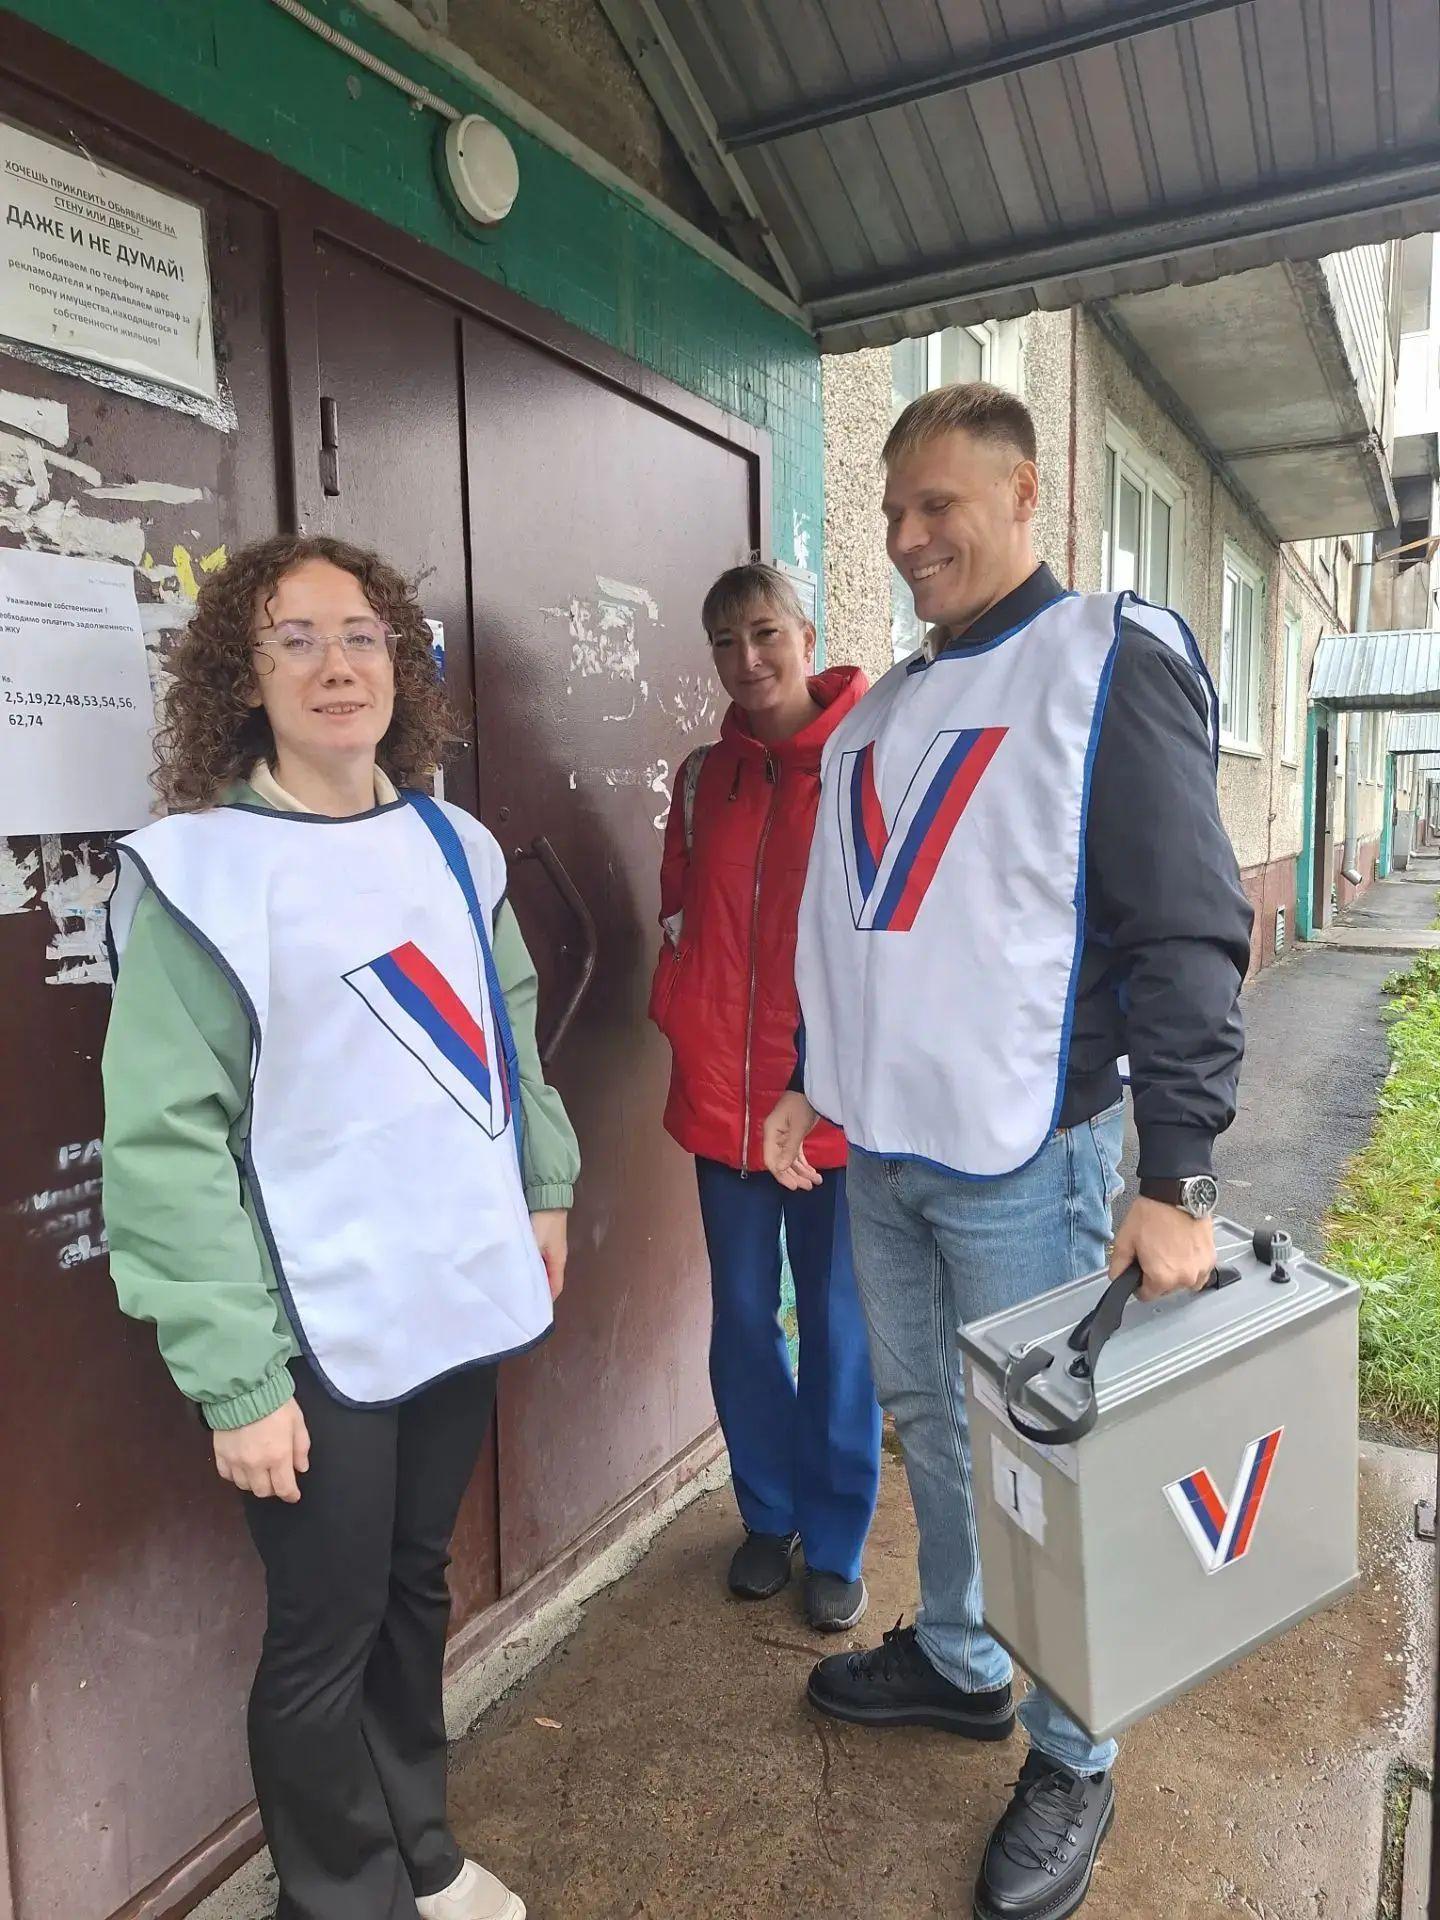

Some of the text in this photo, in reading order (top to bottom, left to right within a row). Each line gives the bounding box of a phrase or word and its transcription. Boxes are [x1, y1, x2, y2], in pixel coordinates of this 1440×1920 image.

[5, 160, 48, 184] ХОЧЕШЬ
[50, 177, 106, 206] ПРИКЛЕИТЬ
[164, 223, 176, 236] НА
[54, 196, 140, 235] СТЕНУ ИЛИ ДВЕРЬ?
[6, 204, 185, 282] ДАЖЕ И НЕ ДУМАЙ!
[32, 246, 169, 301] Пробиваем по телефону адрес
[8, 259, 84, 289] рекламодателя
[94, 286, 152, 311] предъявляем
[154, 307, 181, 322] штраф
[29, 282, 58, 299] порчу
[53, 307, 160, 347] собственности жильцов!
[6, 596, 52, 609] Уважаемые
[54, 602, 103, 614] собственники
[5, 625, 21, 634] ЖКУ
[42, 617, 75, 628] оплатить
[76, 621, 134, 632] задолженность
[4, 691, 137, 710] 2,5,19,22,48,53,54,56,
[8, 714, 43, 728] 62,74
